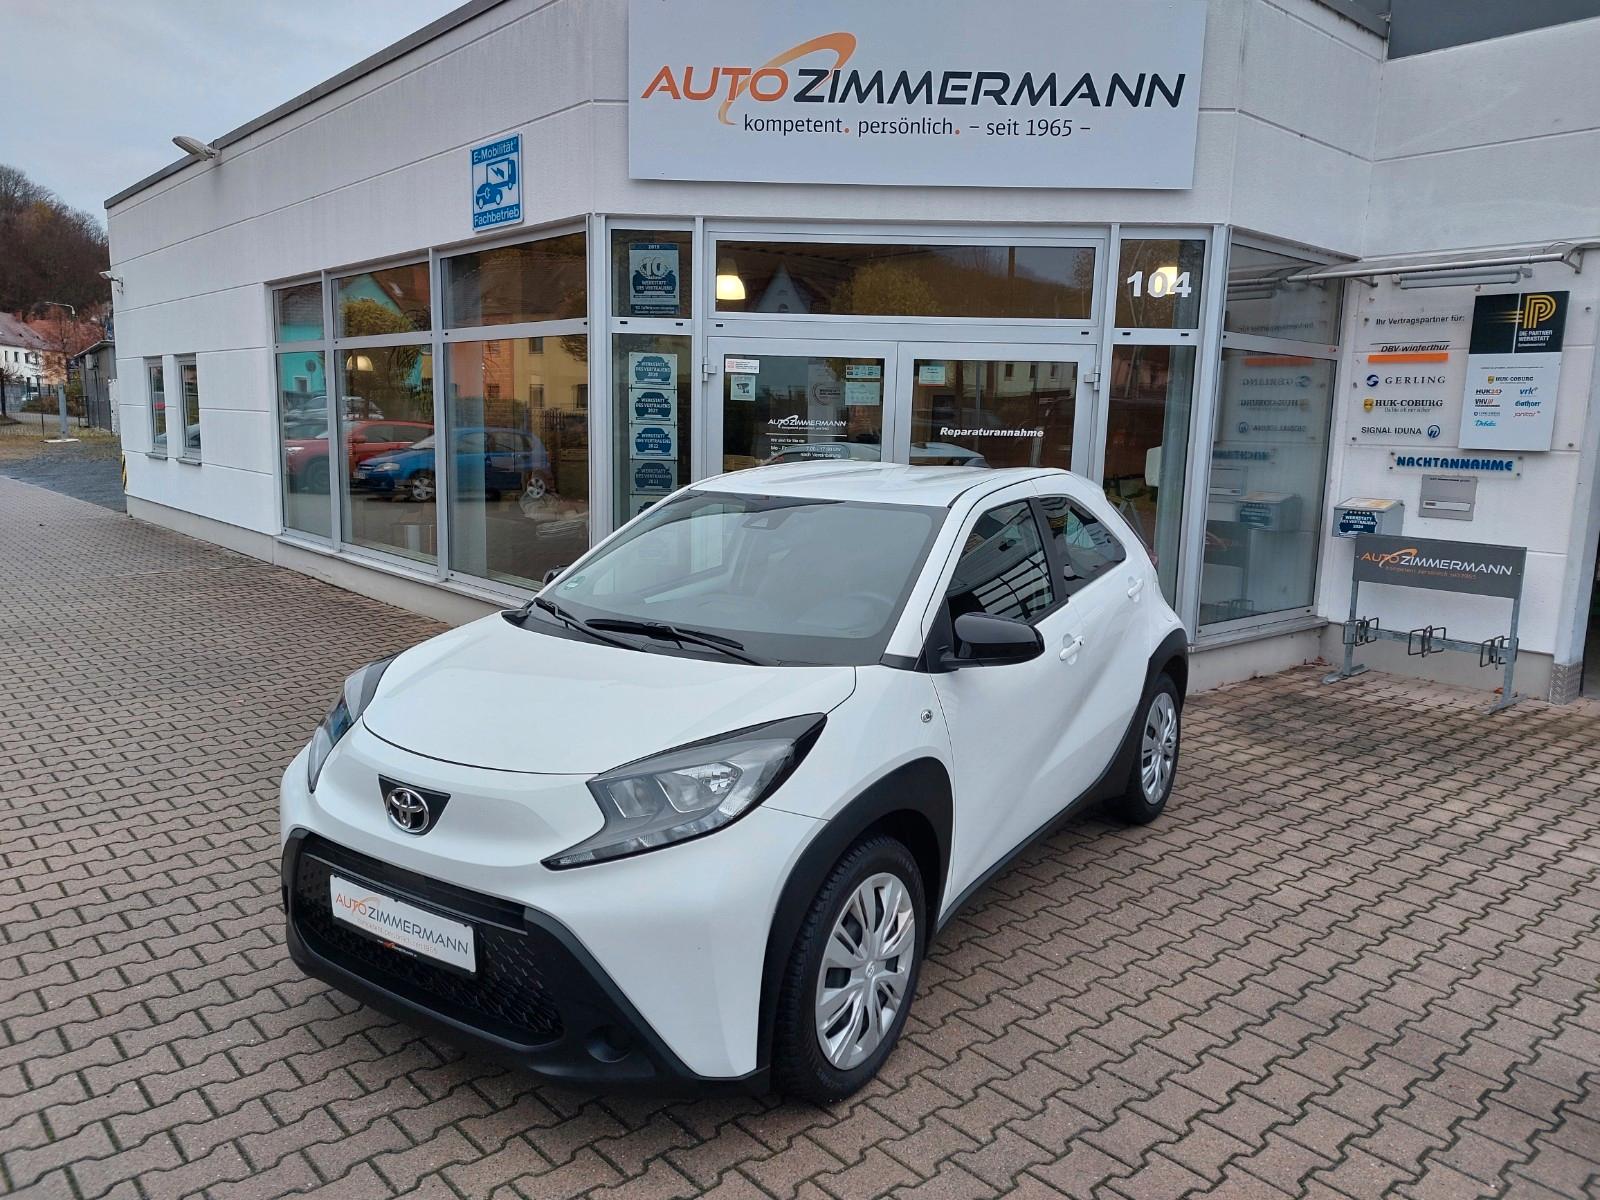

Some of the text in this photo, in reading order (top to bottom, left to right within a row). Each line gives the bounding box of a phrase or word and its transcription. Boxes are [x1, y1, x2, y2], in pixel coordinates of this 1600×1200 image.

[641, 65, 1186, 108] AUTO ZIMMERMANN
[744, 113, 850, 136] kompetent.
[858, 116, 961, 138] persönlich.
[986, 118, 1020, 137] seit
[1026, 118, 1073, 137] 1965
[473, 140, 514, 163] E-Mobilität
[474, 206, 520, 227] Fachbetrieb
[1126, 270, 1192, 298] 104
[1375, 314, 1465, 326] Ihr Vertragspartner für:
[1384, 376, 1446, 385] GERLING
[1375, 399, 1444, 407] HUK-COBURG
[939, 427, 1044, 438] Reparaturannahme
[1361, 426, 1422, 435] SIGNAL IDUNA
[1396, 455, 1514, 471] NACHTANNAHME
[1400, 555, 1513, 576] ZIMMERMANN
[367, 905, 470, 956] ZIMMERMANN
